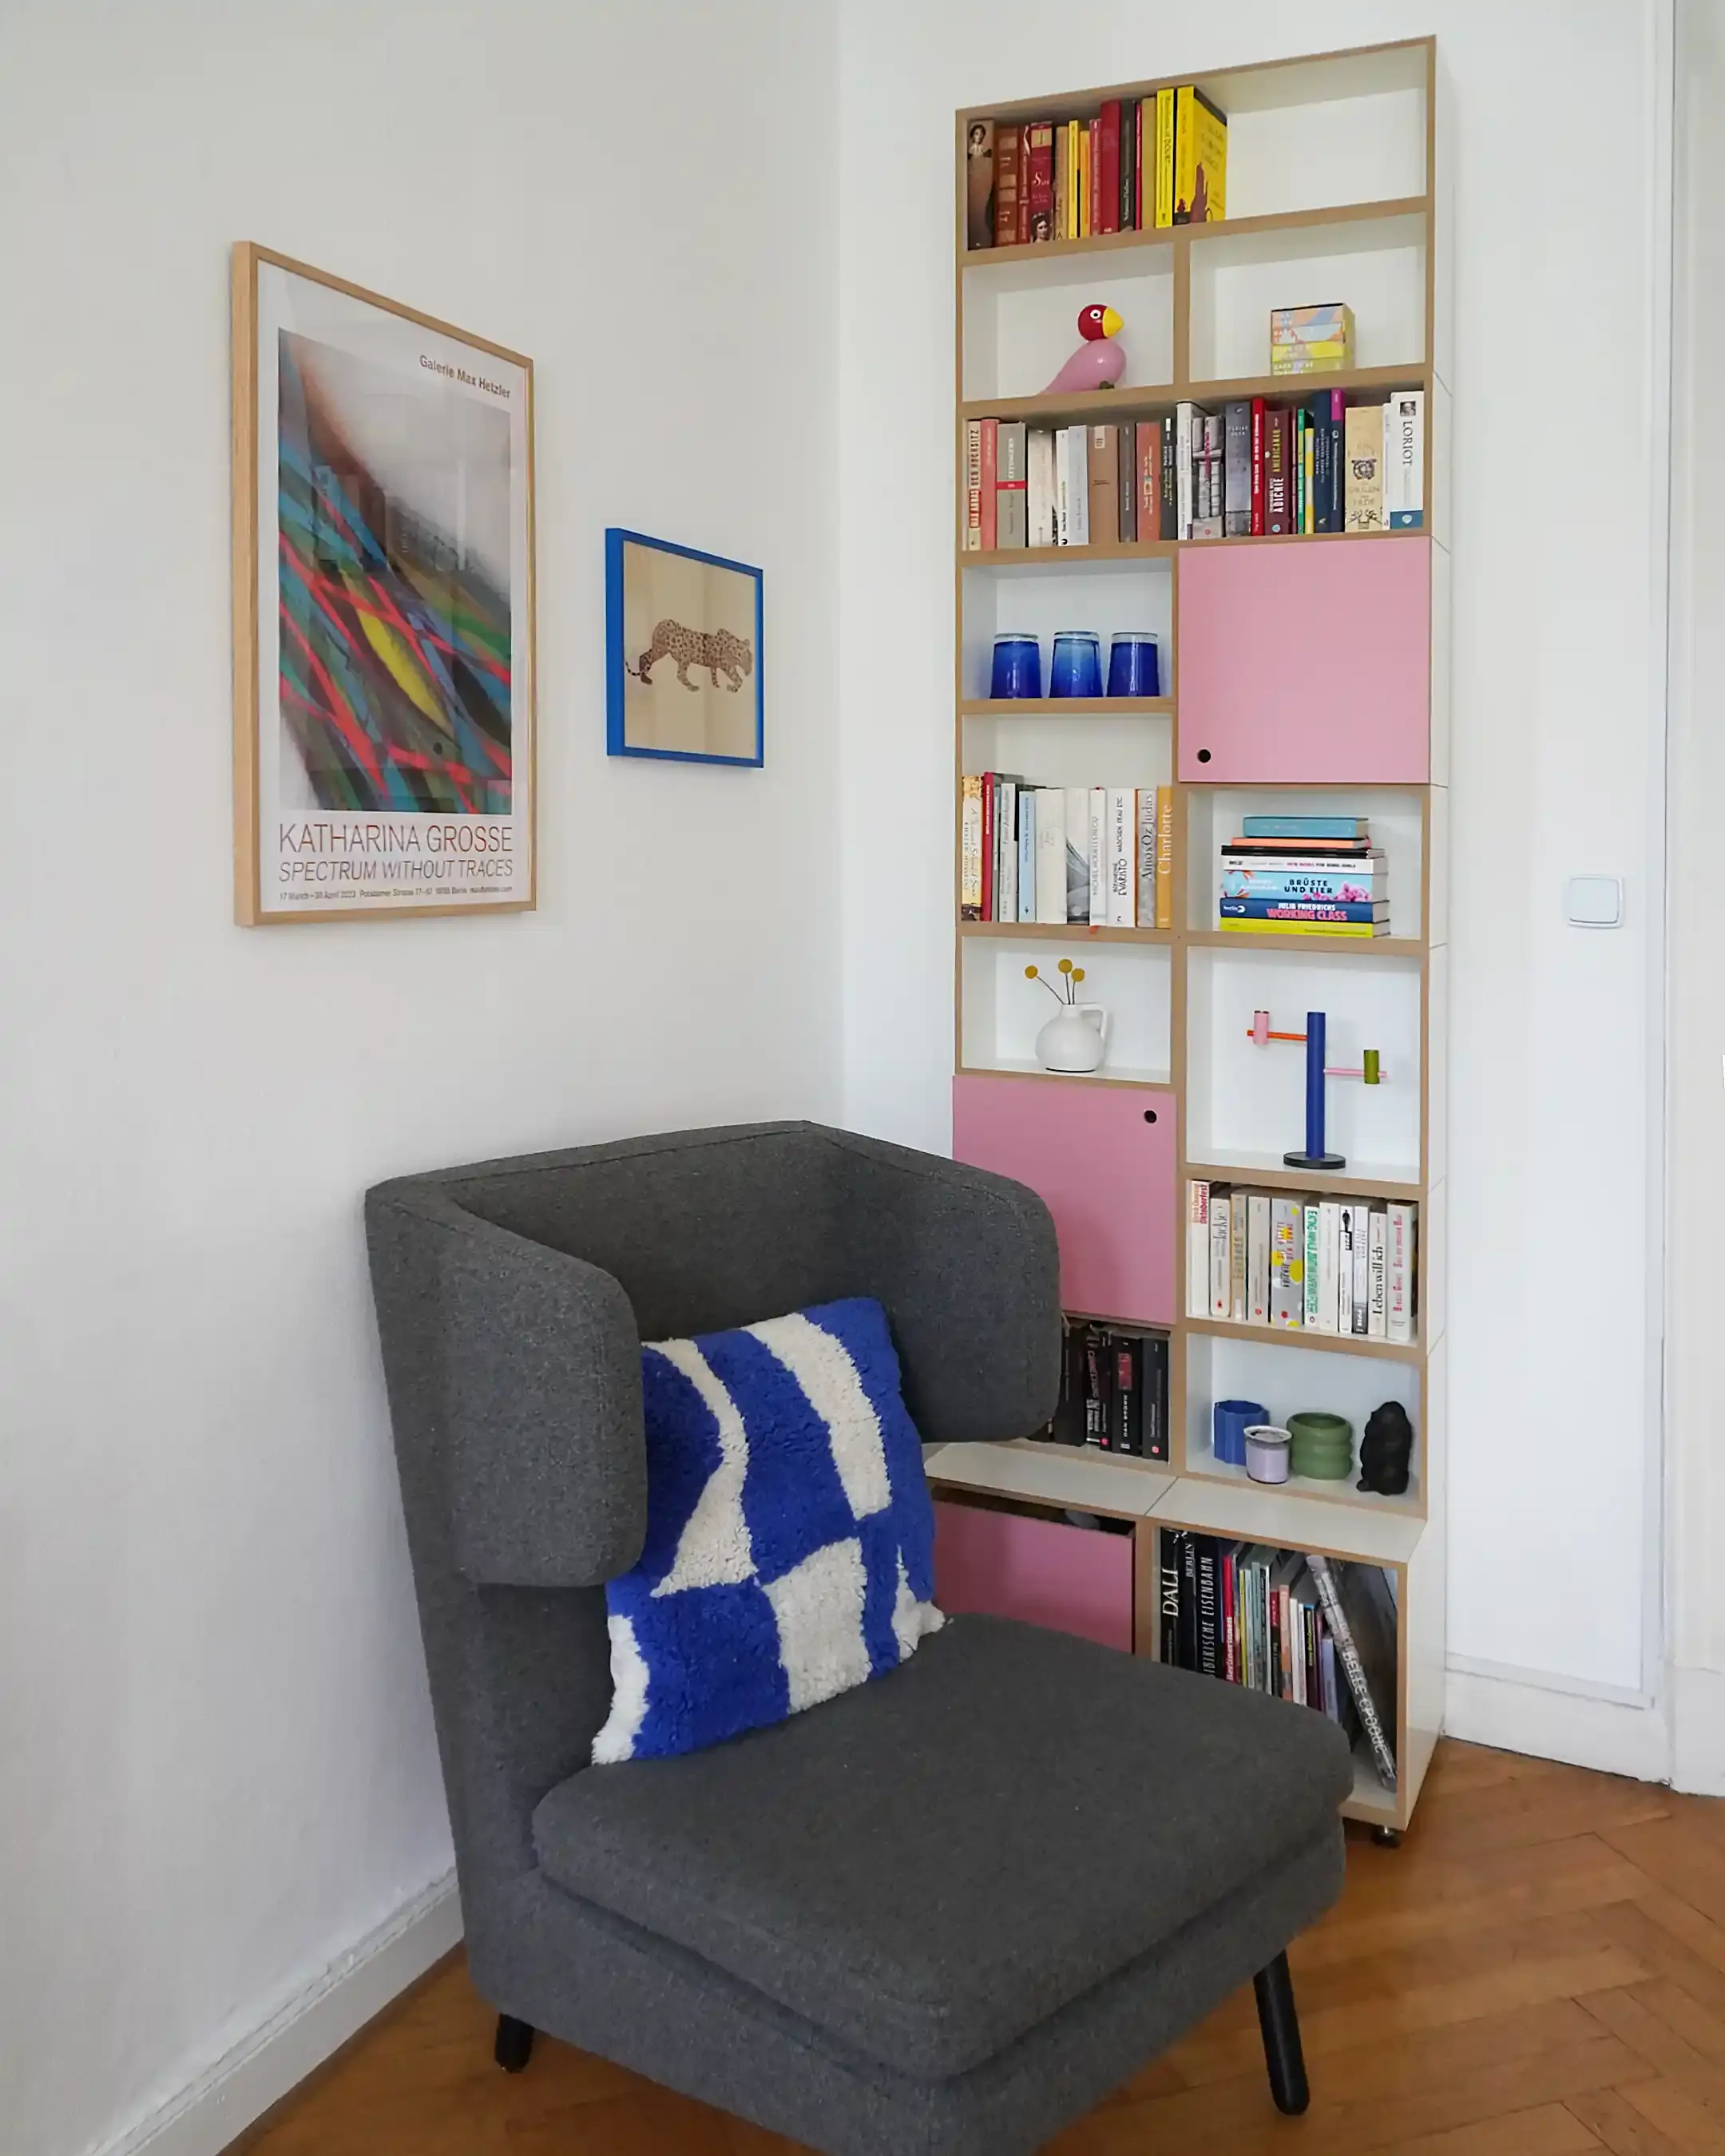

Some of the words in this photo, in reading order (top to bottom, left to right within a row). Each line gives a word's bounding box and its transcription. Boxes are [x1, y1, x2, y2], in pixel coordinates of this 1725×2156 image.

[419, 355, 454, 378] Galerie
[457, 368, 477, 386] Max
[479, 377, 511, 399] Hetzler
[1402, 420, 1413, 467] LORIOT
[1274, 477, 1284, 513] ADICHIE
[1140, 795, 1155, 827] Judas
[280, 823, 421, 853] KATHARINA
[426, 824, 514, 853] GROSSE
[1140, 828, 1152, 846] Oz
[1157, 804, 1173, 874] Charlotte
[280, 860, 378, 882] SPECTRUM
[382, 859, 454, 879] WITHOUT
[458, 858, 514, 878] TRACES
[1117, 858, 1127, 896] EVARISTO
[1141, 847, 1153, 882] Amos
[1289, 877, 1328, 886] BRÜSTE
[1266, 908, 1315, 920] WORKING
[1316, 910, 1348, 921] CLASS
[1297, 903, 1336, 912] FRIEDRICHS
[1372, 1246, 1383, 1261] ich
[1372, 1263, 1383, 1282] will
[1372, 1283, 1383, 1314] Leben
[1200, 1556, 1215, 1616] EISENBAHN
[1225, 1616, 1234, 1681] Berlinerinnen
[1342, 1651, 1367, 1695] BELLE
